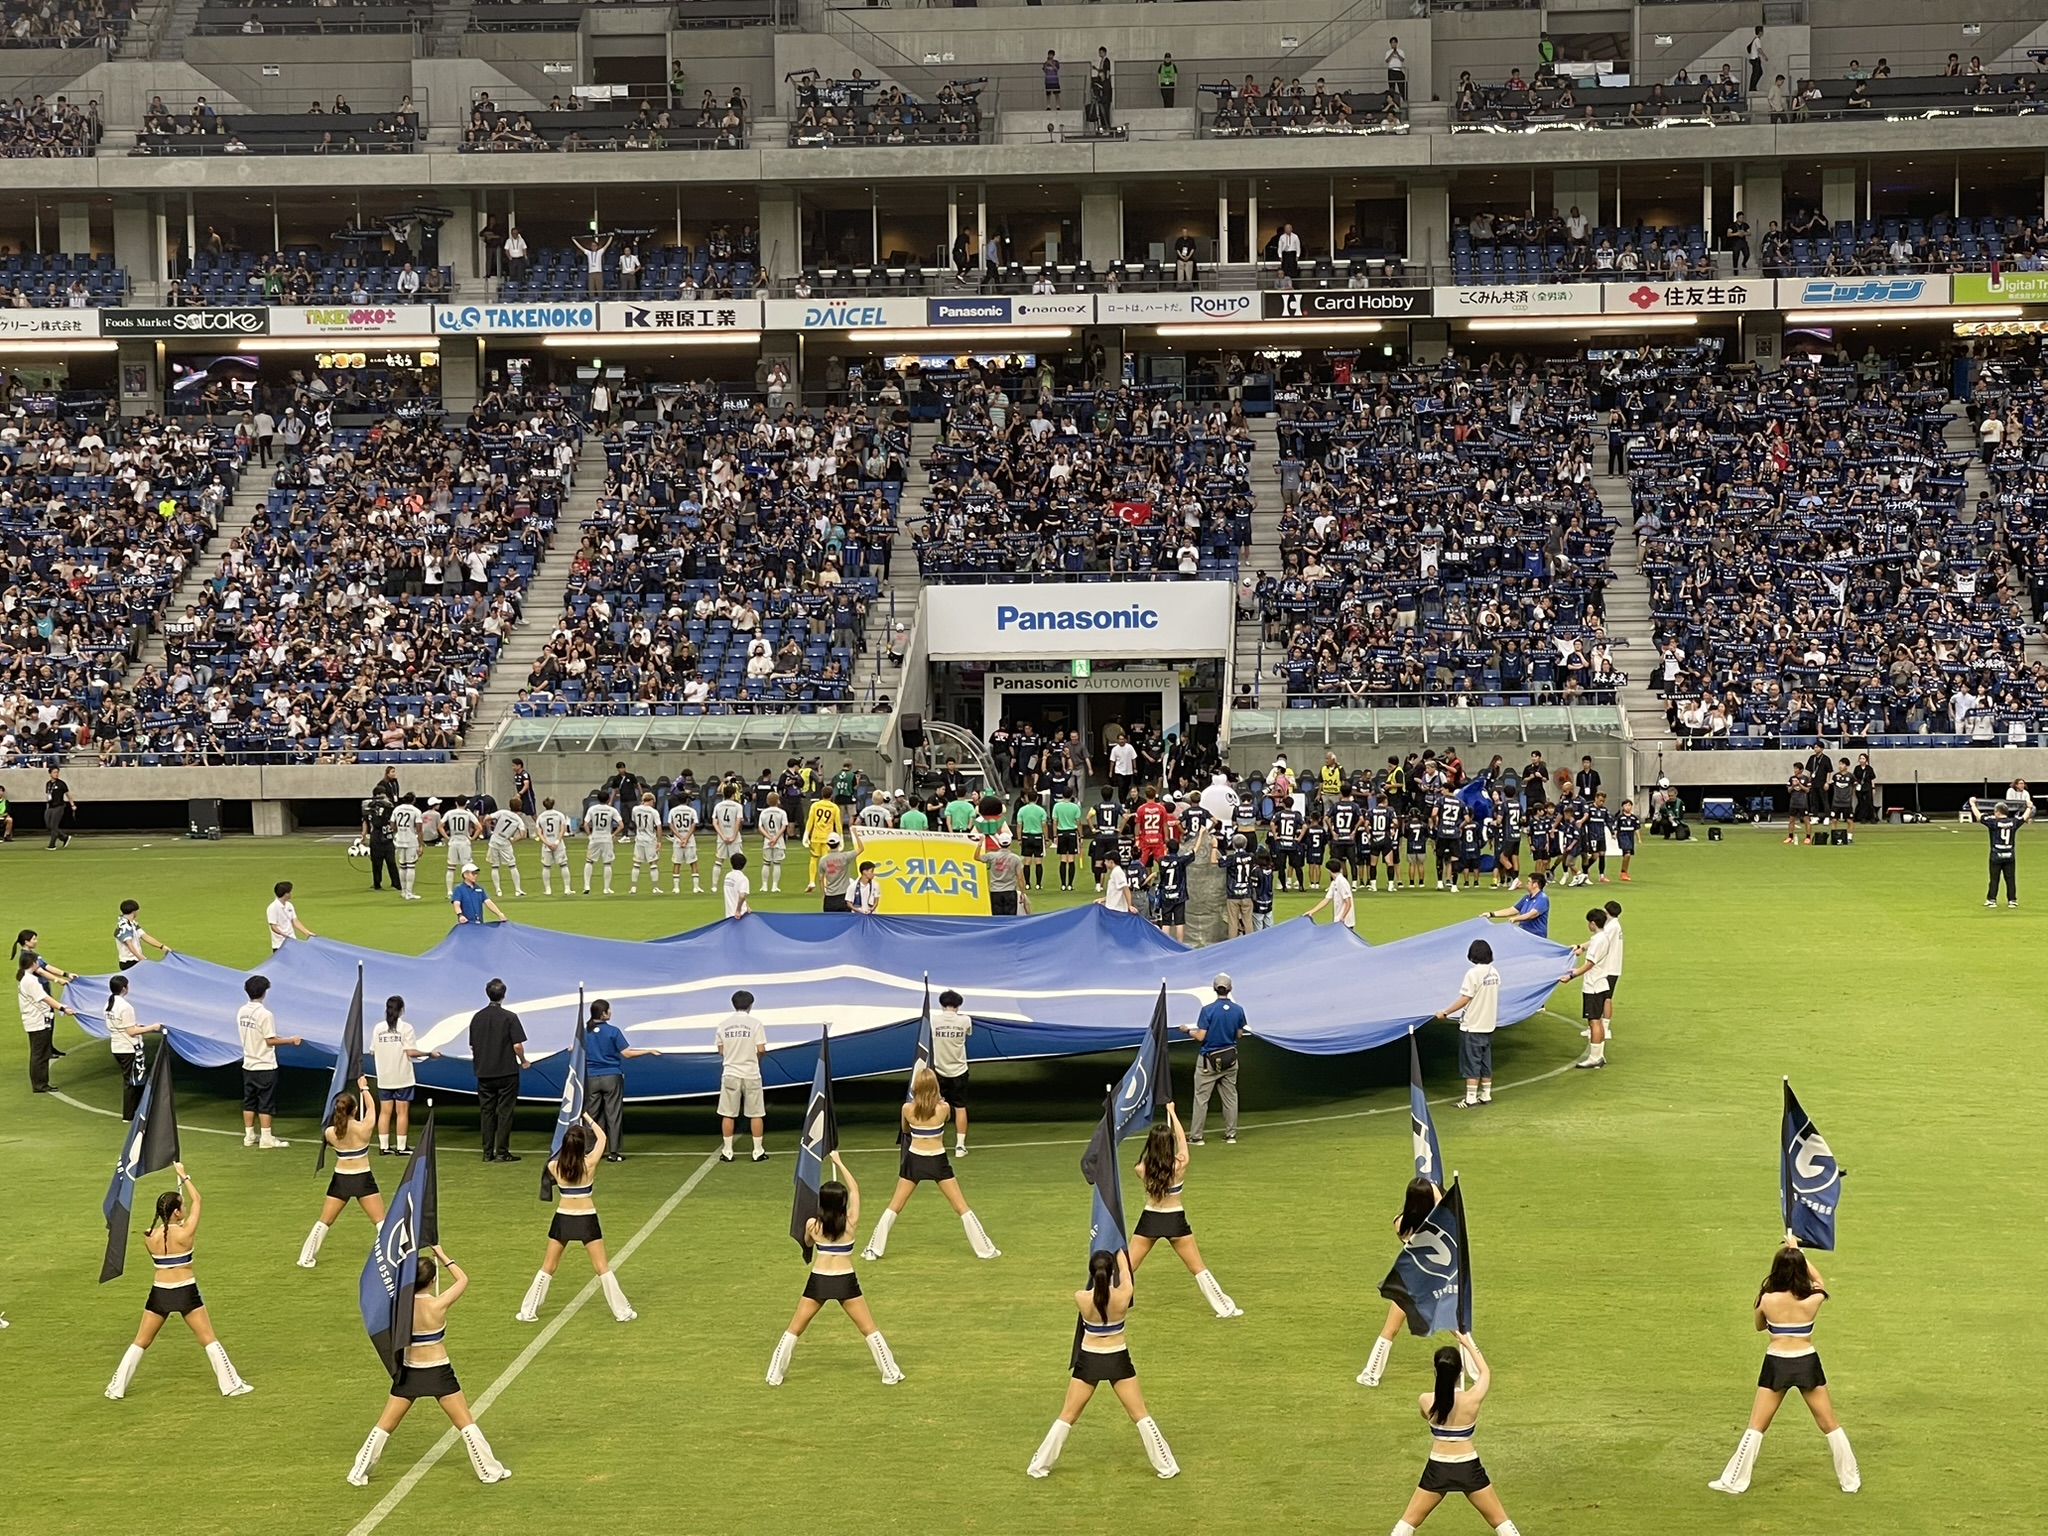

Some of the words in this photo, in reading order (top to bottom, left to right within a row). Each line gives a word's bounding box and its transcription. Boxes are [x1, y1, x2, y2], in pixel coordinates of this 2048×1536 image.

[1663, 285, 1748, 306] 住友生命
[1801, 279, 1927, 304] ニッカン
[939, 303, 1004, 318] Panasonic
[1190, 295, 1251, 314] ROHTO
[1313, 294, 1357, 311] Card
[1359, 293, 1415, 313] Hobby
[105, 318, 134, 328] Foods
[136, 317, 172, 328] Market
[173, 311, 264, 333] satake
[485, 307, 593, 328] TAKENOKO
[656, 308, 736, 327] 栗原工業
[996, 602, 1159, 632] Panasonic
[992, 676, 1079, 690] Panasonic
[1083, 676, 1171, 690] AUTOMOTIVE
[396, 811, 411, 828] 22
[594, 812, 608, 828] 15
[816, 807, 832, 824] 99
[866, 813, 881, 827] 19
[1103, 810, 1113, 826] 4
[1335, 811, 1353, 828] 67
[1442, 803, 1461, 821] 23
[452, 816, 466, 832] 10
[501, 818, 512, 833] 7
[546, 817, 554, 833] 5
[674, 813, 690, 828] 35
[768, 814, 775, 829] 6
[1144, 814, 1161, 830] 22
[1191, 816, 1200, 832] 8
[1280, 819, 1294, 835] 16
[1372, 814, 1387, 831] 10
[1312, 834, 1320, 848] 5
[1412, 828, 1421, 842] 7
[1466, 829, 1474, 843] 8
[724, 1030, 751, 1038] HEISEI
